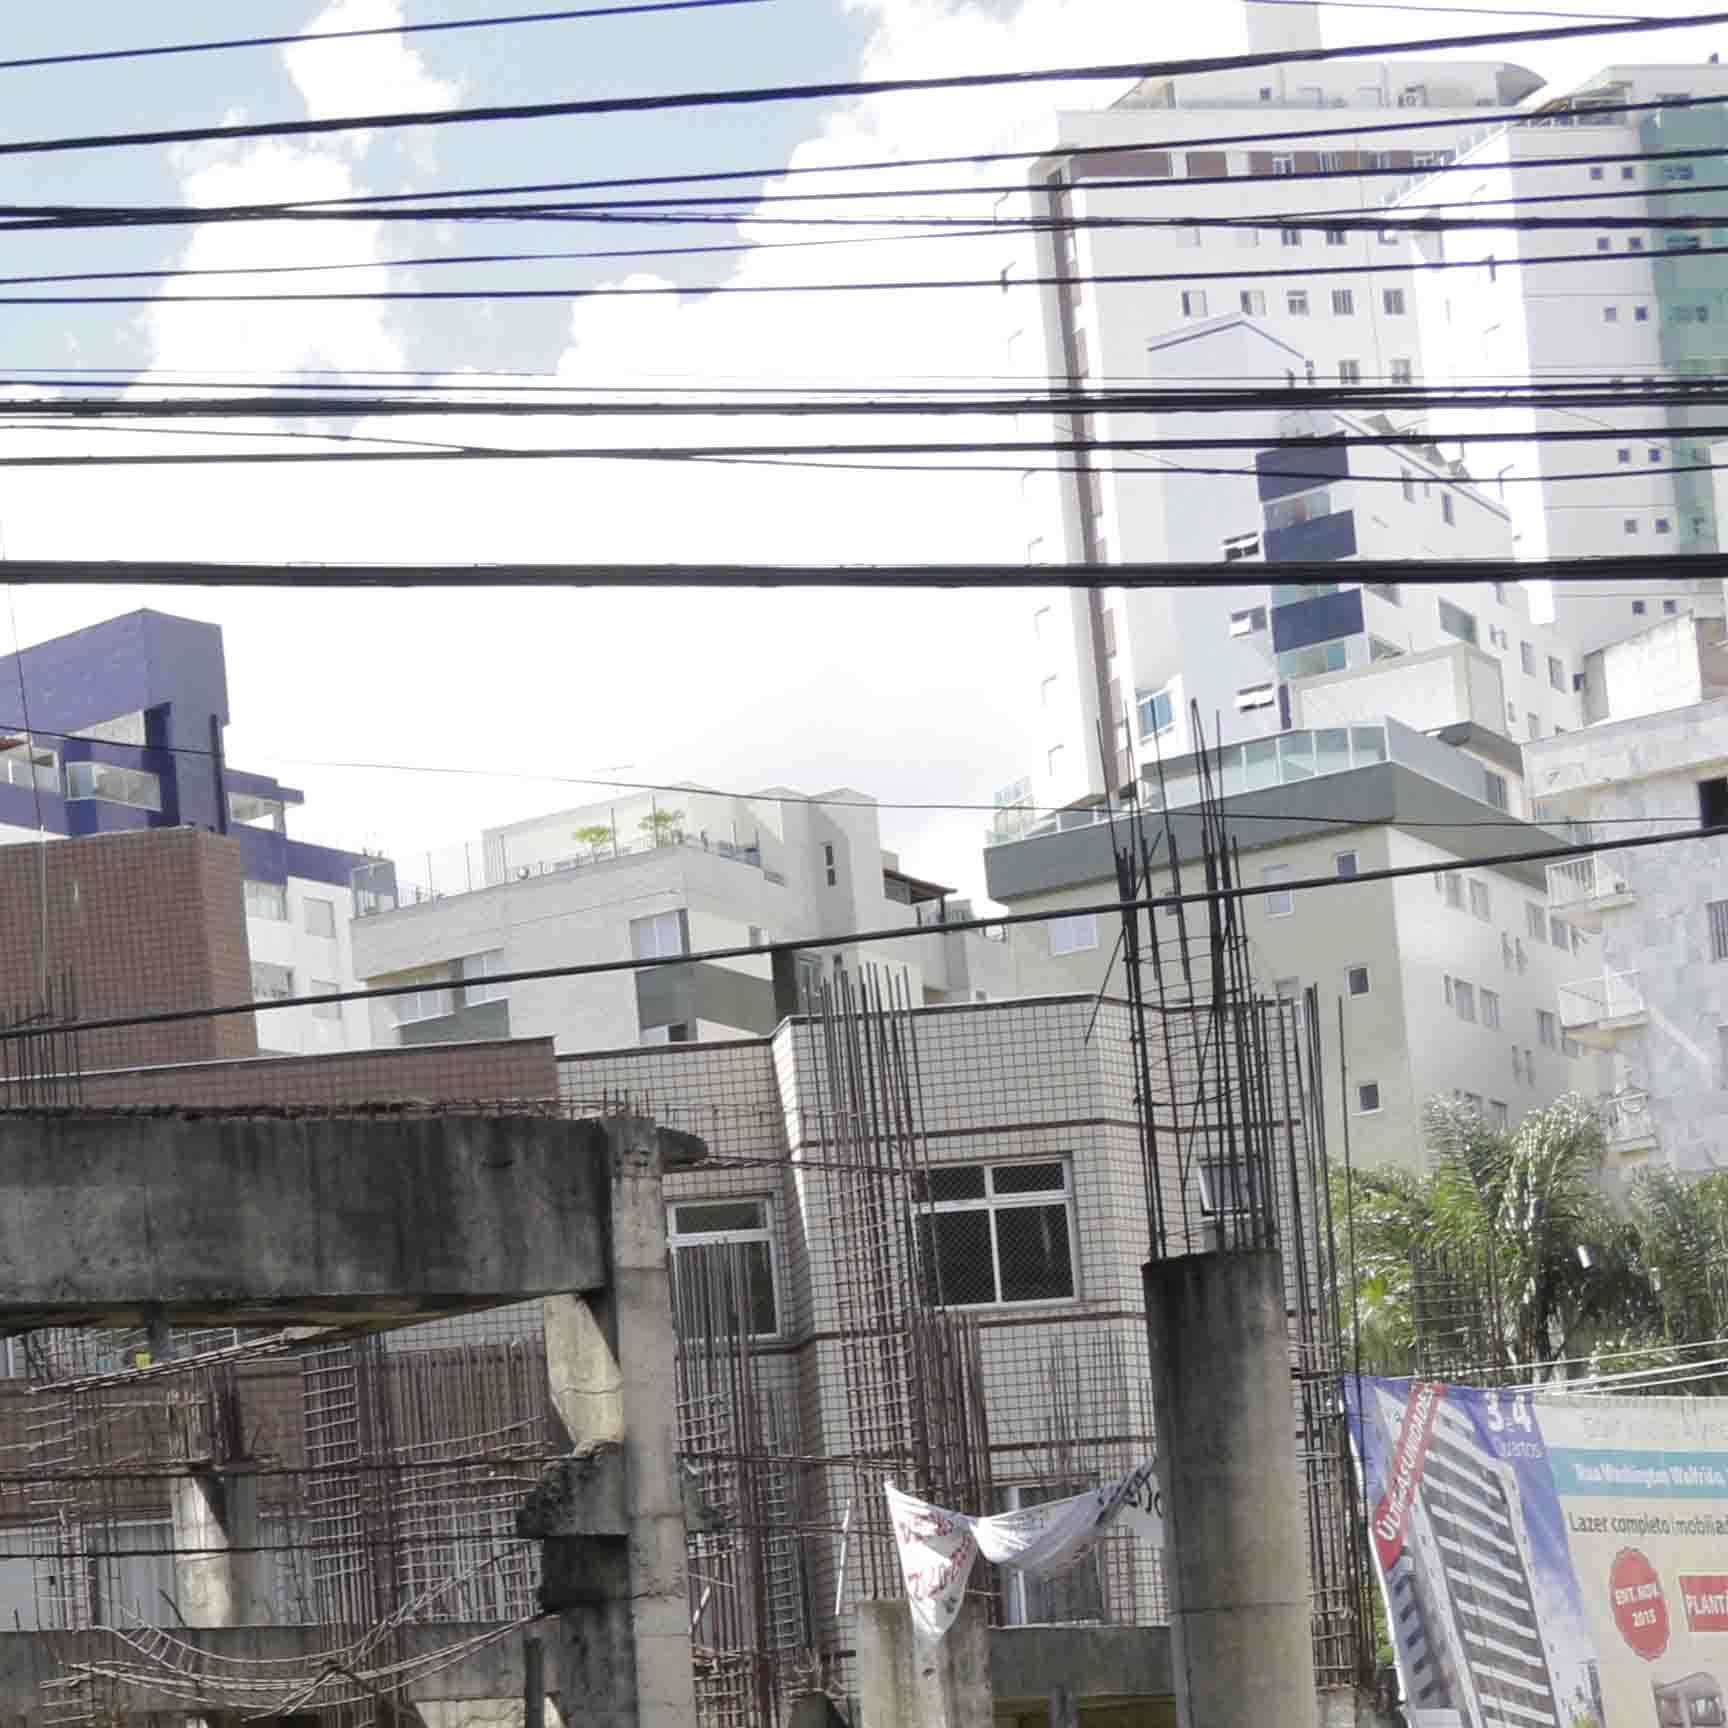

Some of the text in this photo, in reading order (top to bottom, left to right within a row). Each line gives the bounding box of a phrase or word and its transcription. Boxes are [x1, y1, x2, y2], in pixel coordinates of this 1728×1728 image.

[1485, 1391, 1504, 1432] 3
[1512, 1394, 1532, 1433] 4
[1569, 1511, 1609, 1533] Lazer
[1610, 1512, 1671, 1537] completo
